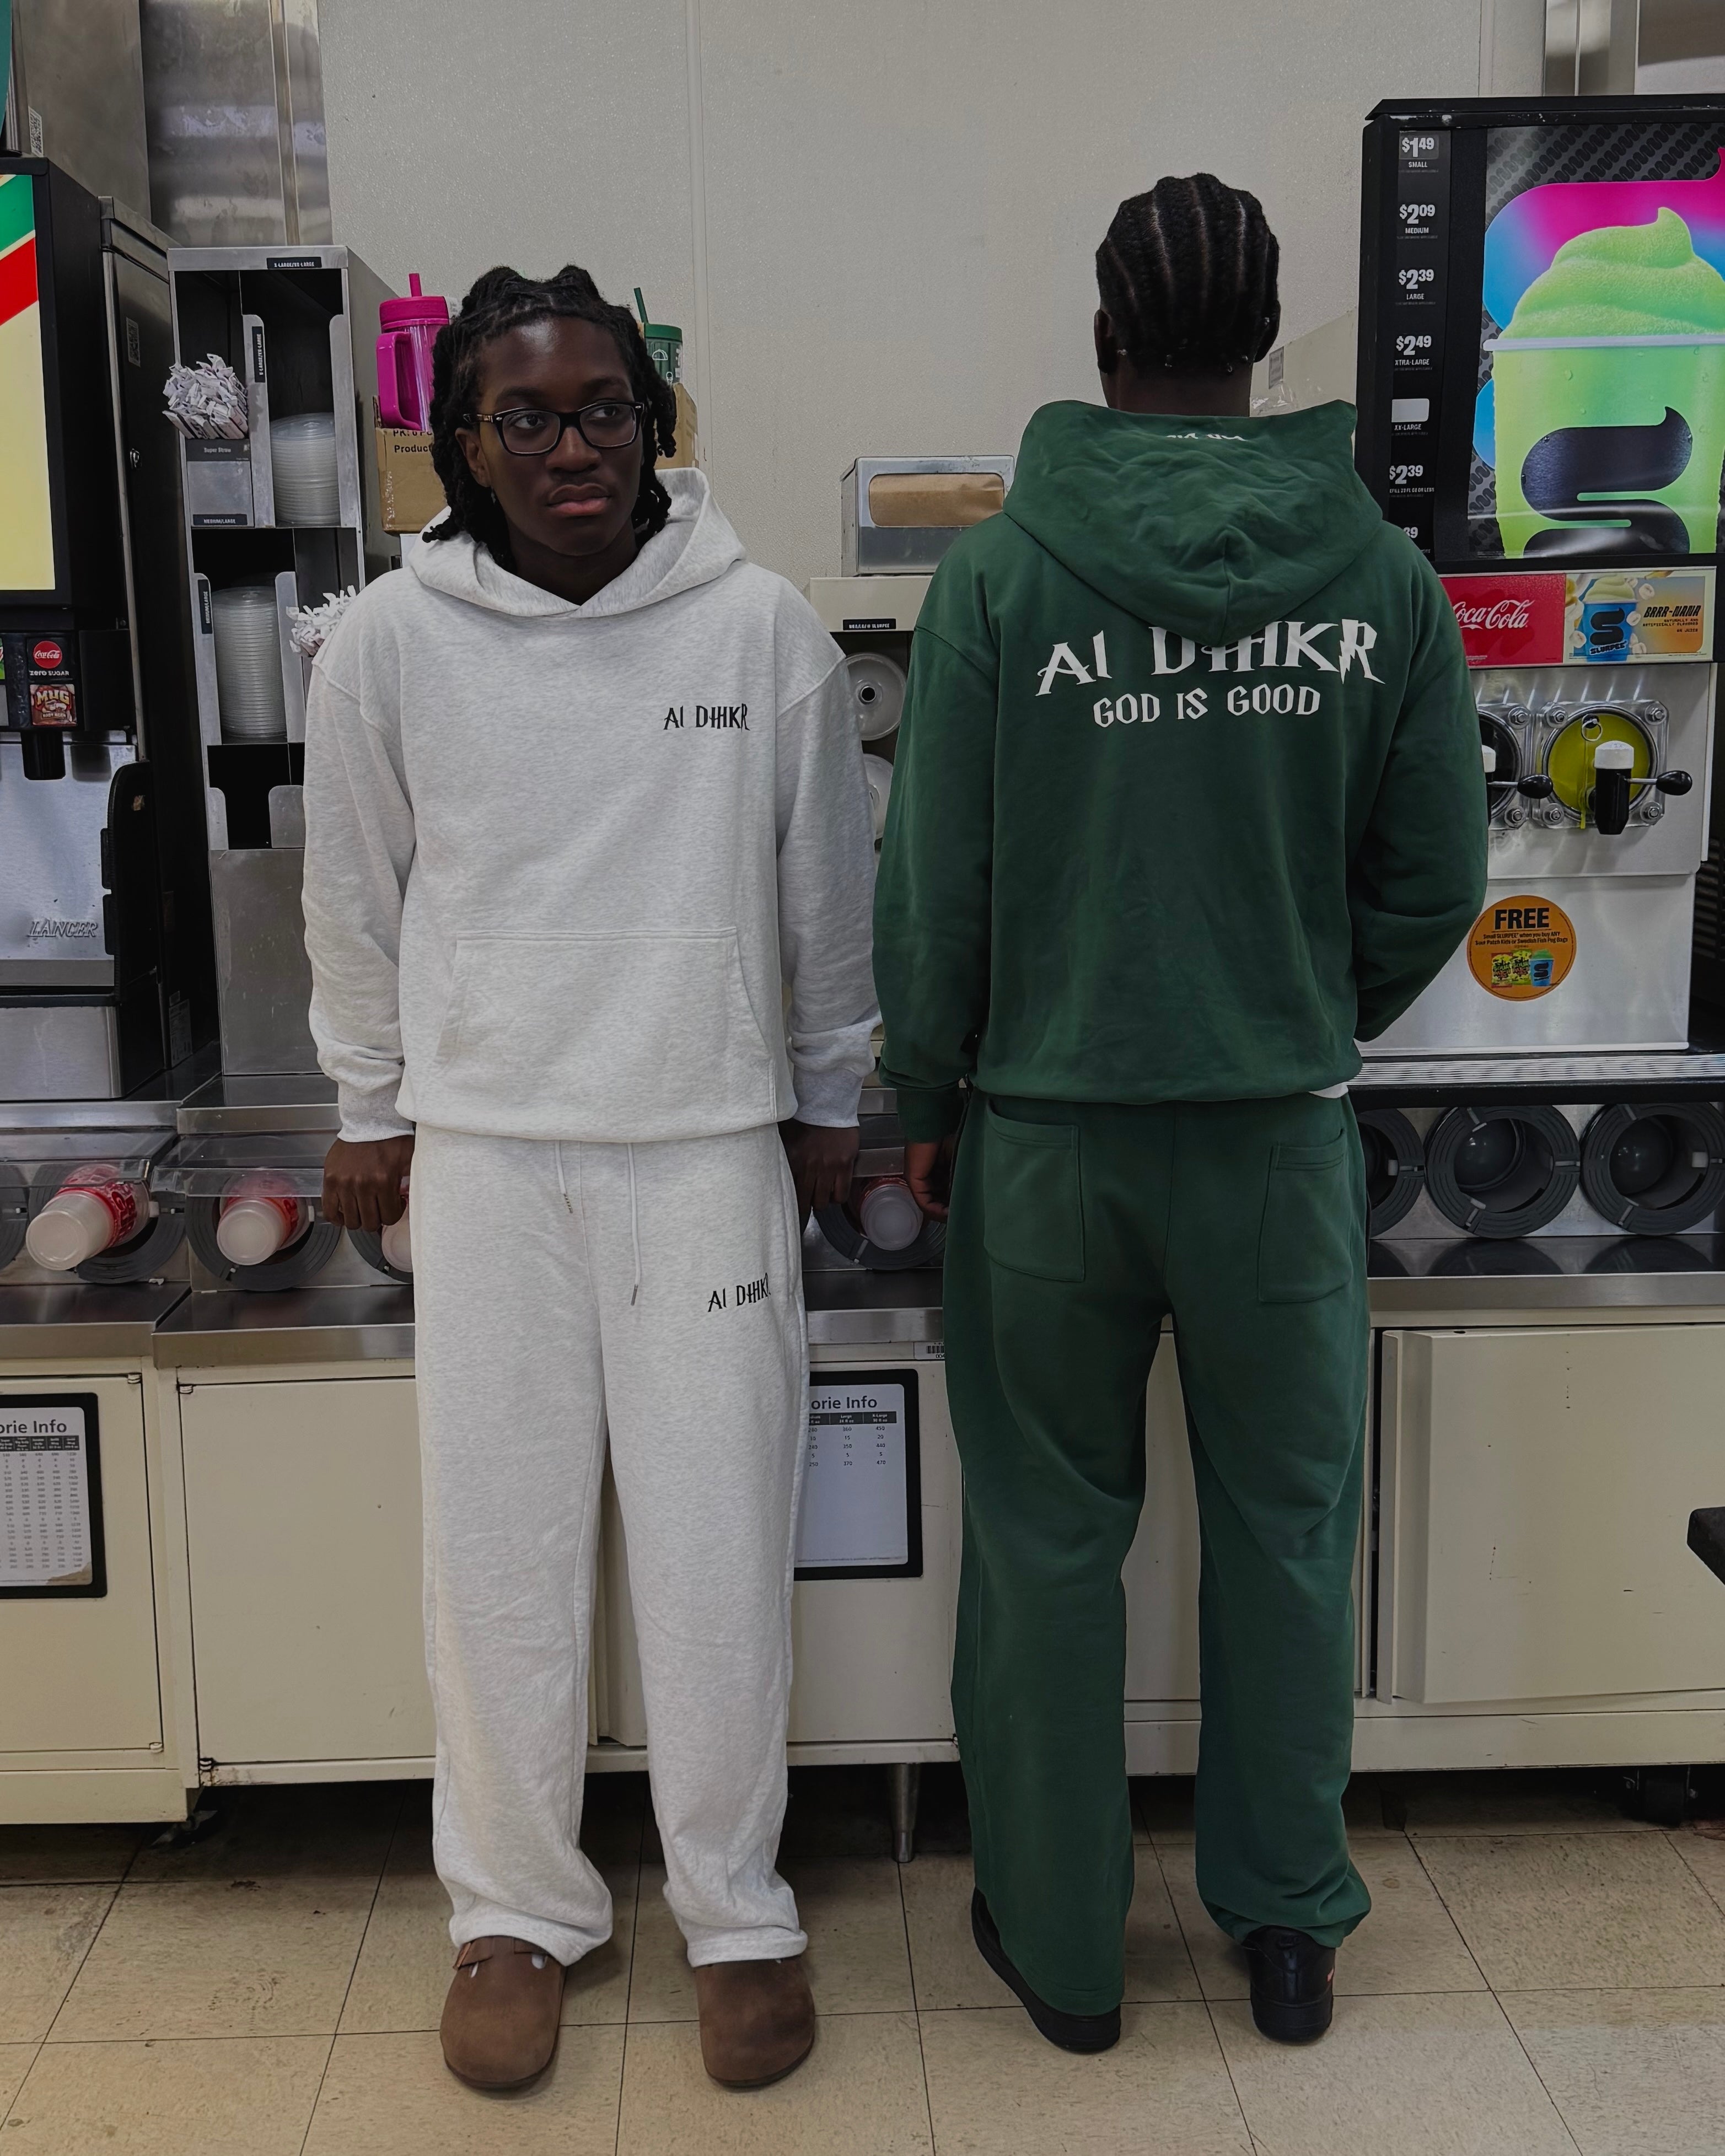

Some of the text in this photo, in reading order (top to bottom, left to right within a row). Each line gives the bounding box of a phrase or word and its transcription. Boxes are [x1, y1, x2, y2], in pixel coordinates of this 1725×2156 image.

[36, 690, 70, 706] MUG
[1093, 684, 1321, 728] GOD IS GOOD
[1495, 907, 1550, 930] FREE
[28, 919, 98, 938] LANCER
[846, 1395, 878, 1409] Info
[33, 1420, 67, 1433] Info
